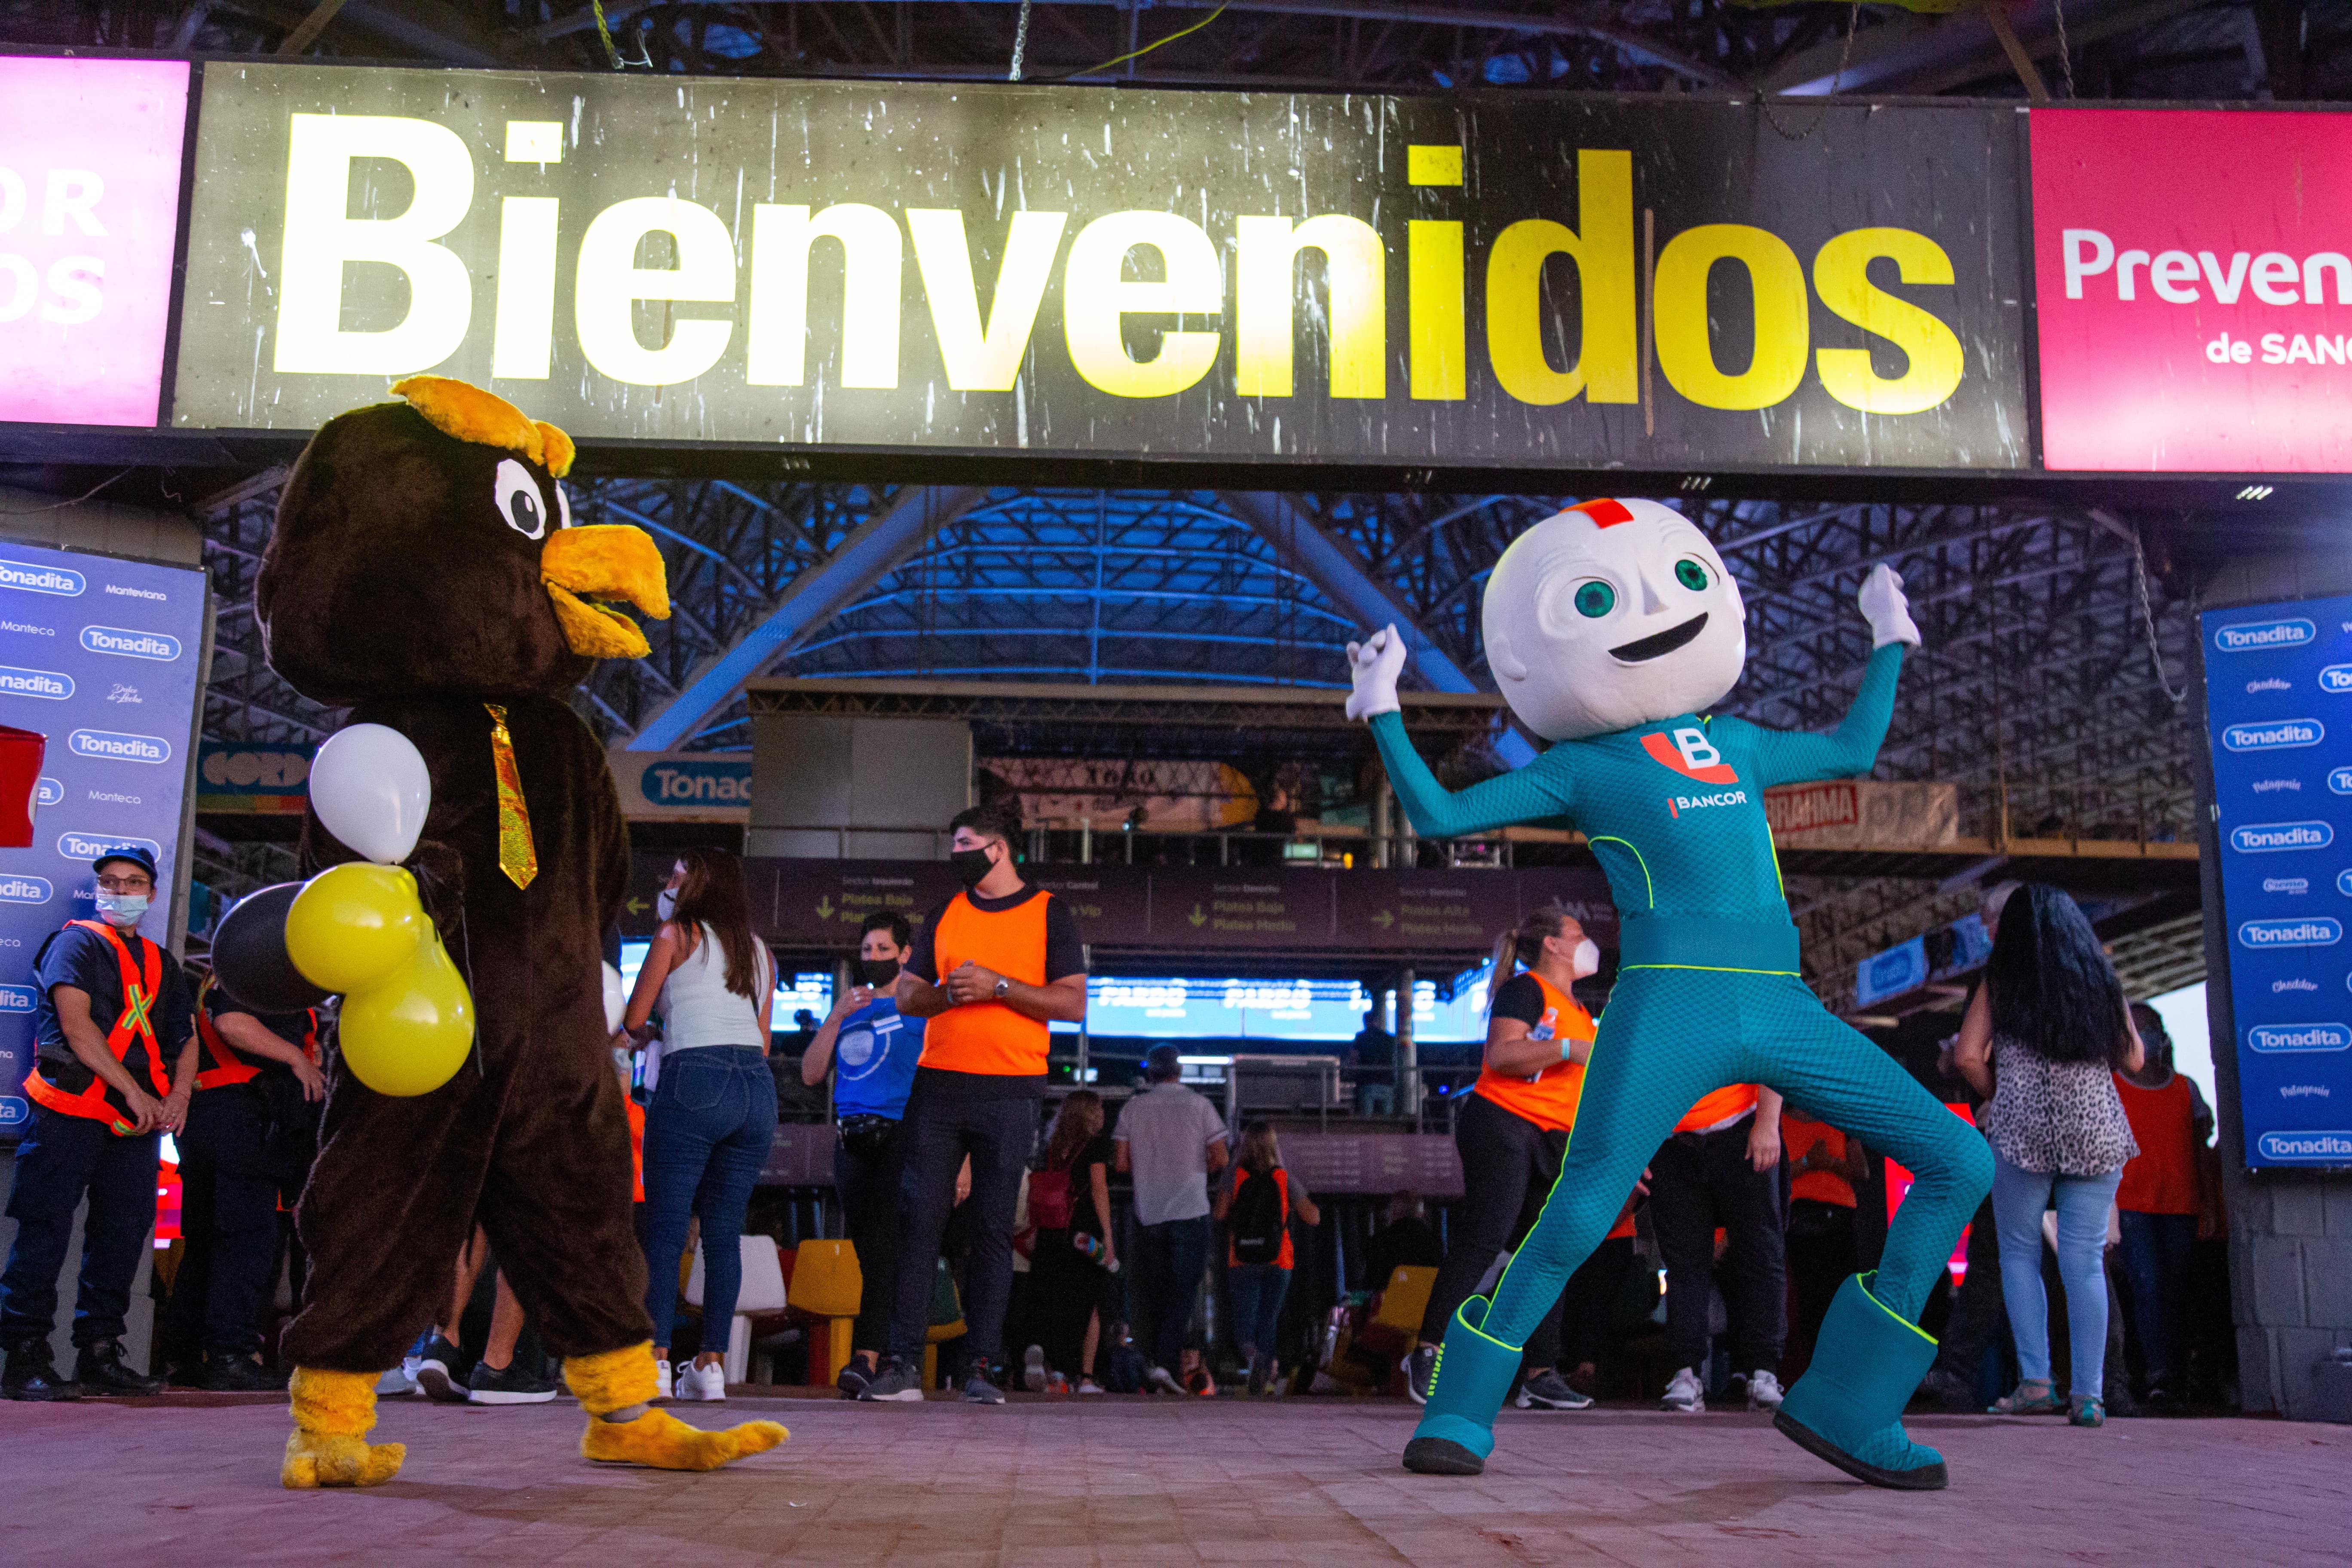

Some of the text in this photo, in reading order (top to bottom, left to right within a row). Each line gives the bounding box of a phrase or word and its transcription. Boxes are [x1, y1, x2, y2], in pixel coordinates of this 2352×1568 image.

[274, 113, 1963, 415] Bienvenidos
[2063, 229, 2352, 306] Preven
[2206, 332, 2252, 364] de
[1, 620, 55, 636] Manteca
[2223, 625, 2305, 646] Tonadita
[89, 631, 170, 655] Tonadita
[0, 675, 63, 694] nadita
[78, 734, 160, 758] Tonadita
[2231, 726, 2313, 746] Tonadita
[1673, 728, 1720, 769] B
[89, 790, 141, 804] Manteca
[1676, 791, 1747, 809] BANCOR
[2240, 828, 2322, 848] Tonadita
[2247, 924, 2331, 942] Tonadita
[2257, 1029, 2342, 1047] Tonadita
[2267, 1137, 2352, 1154] Tonadita
